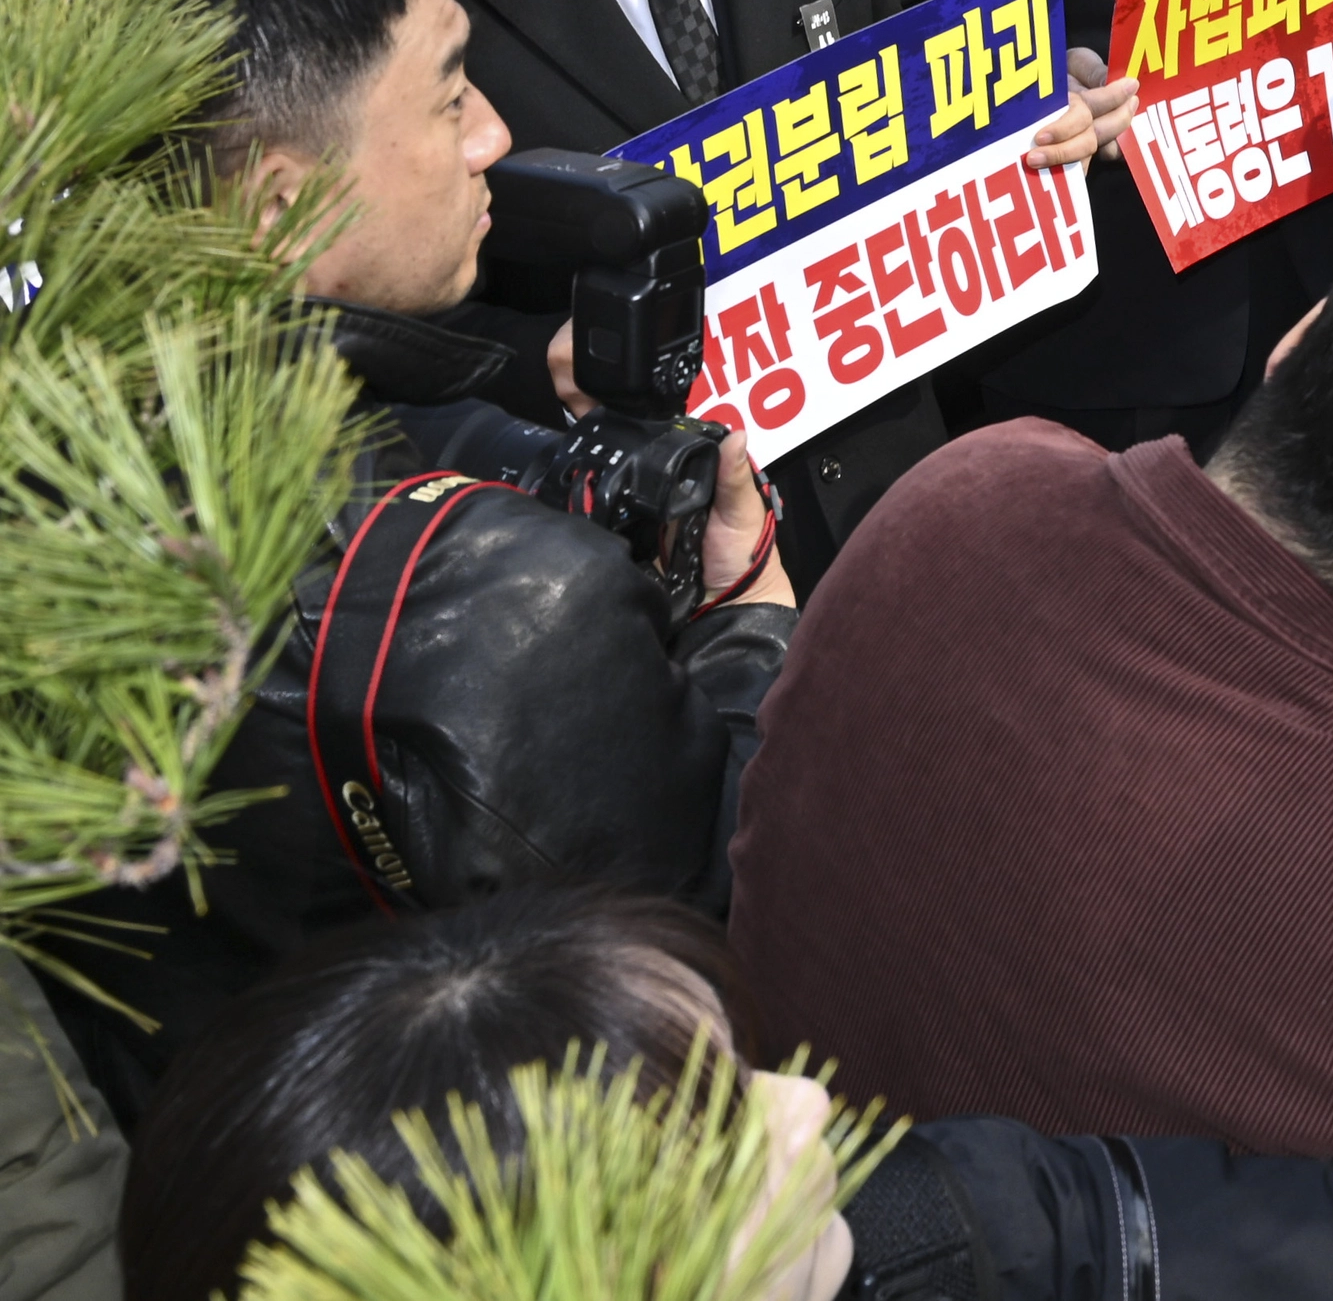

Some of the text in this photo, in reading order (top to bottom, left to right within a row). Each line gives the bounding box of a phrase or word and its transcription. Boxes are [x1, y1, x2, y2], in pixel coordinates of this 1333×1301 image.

[1129, 56, 1312, 237] 대통령은
[802, 152, 1086, 385] 중단하라!
[342, 781, 413, 889] Canon
